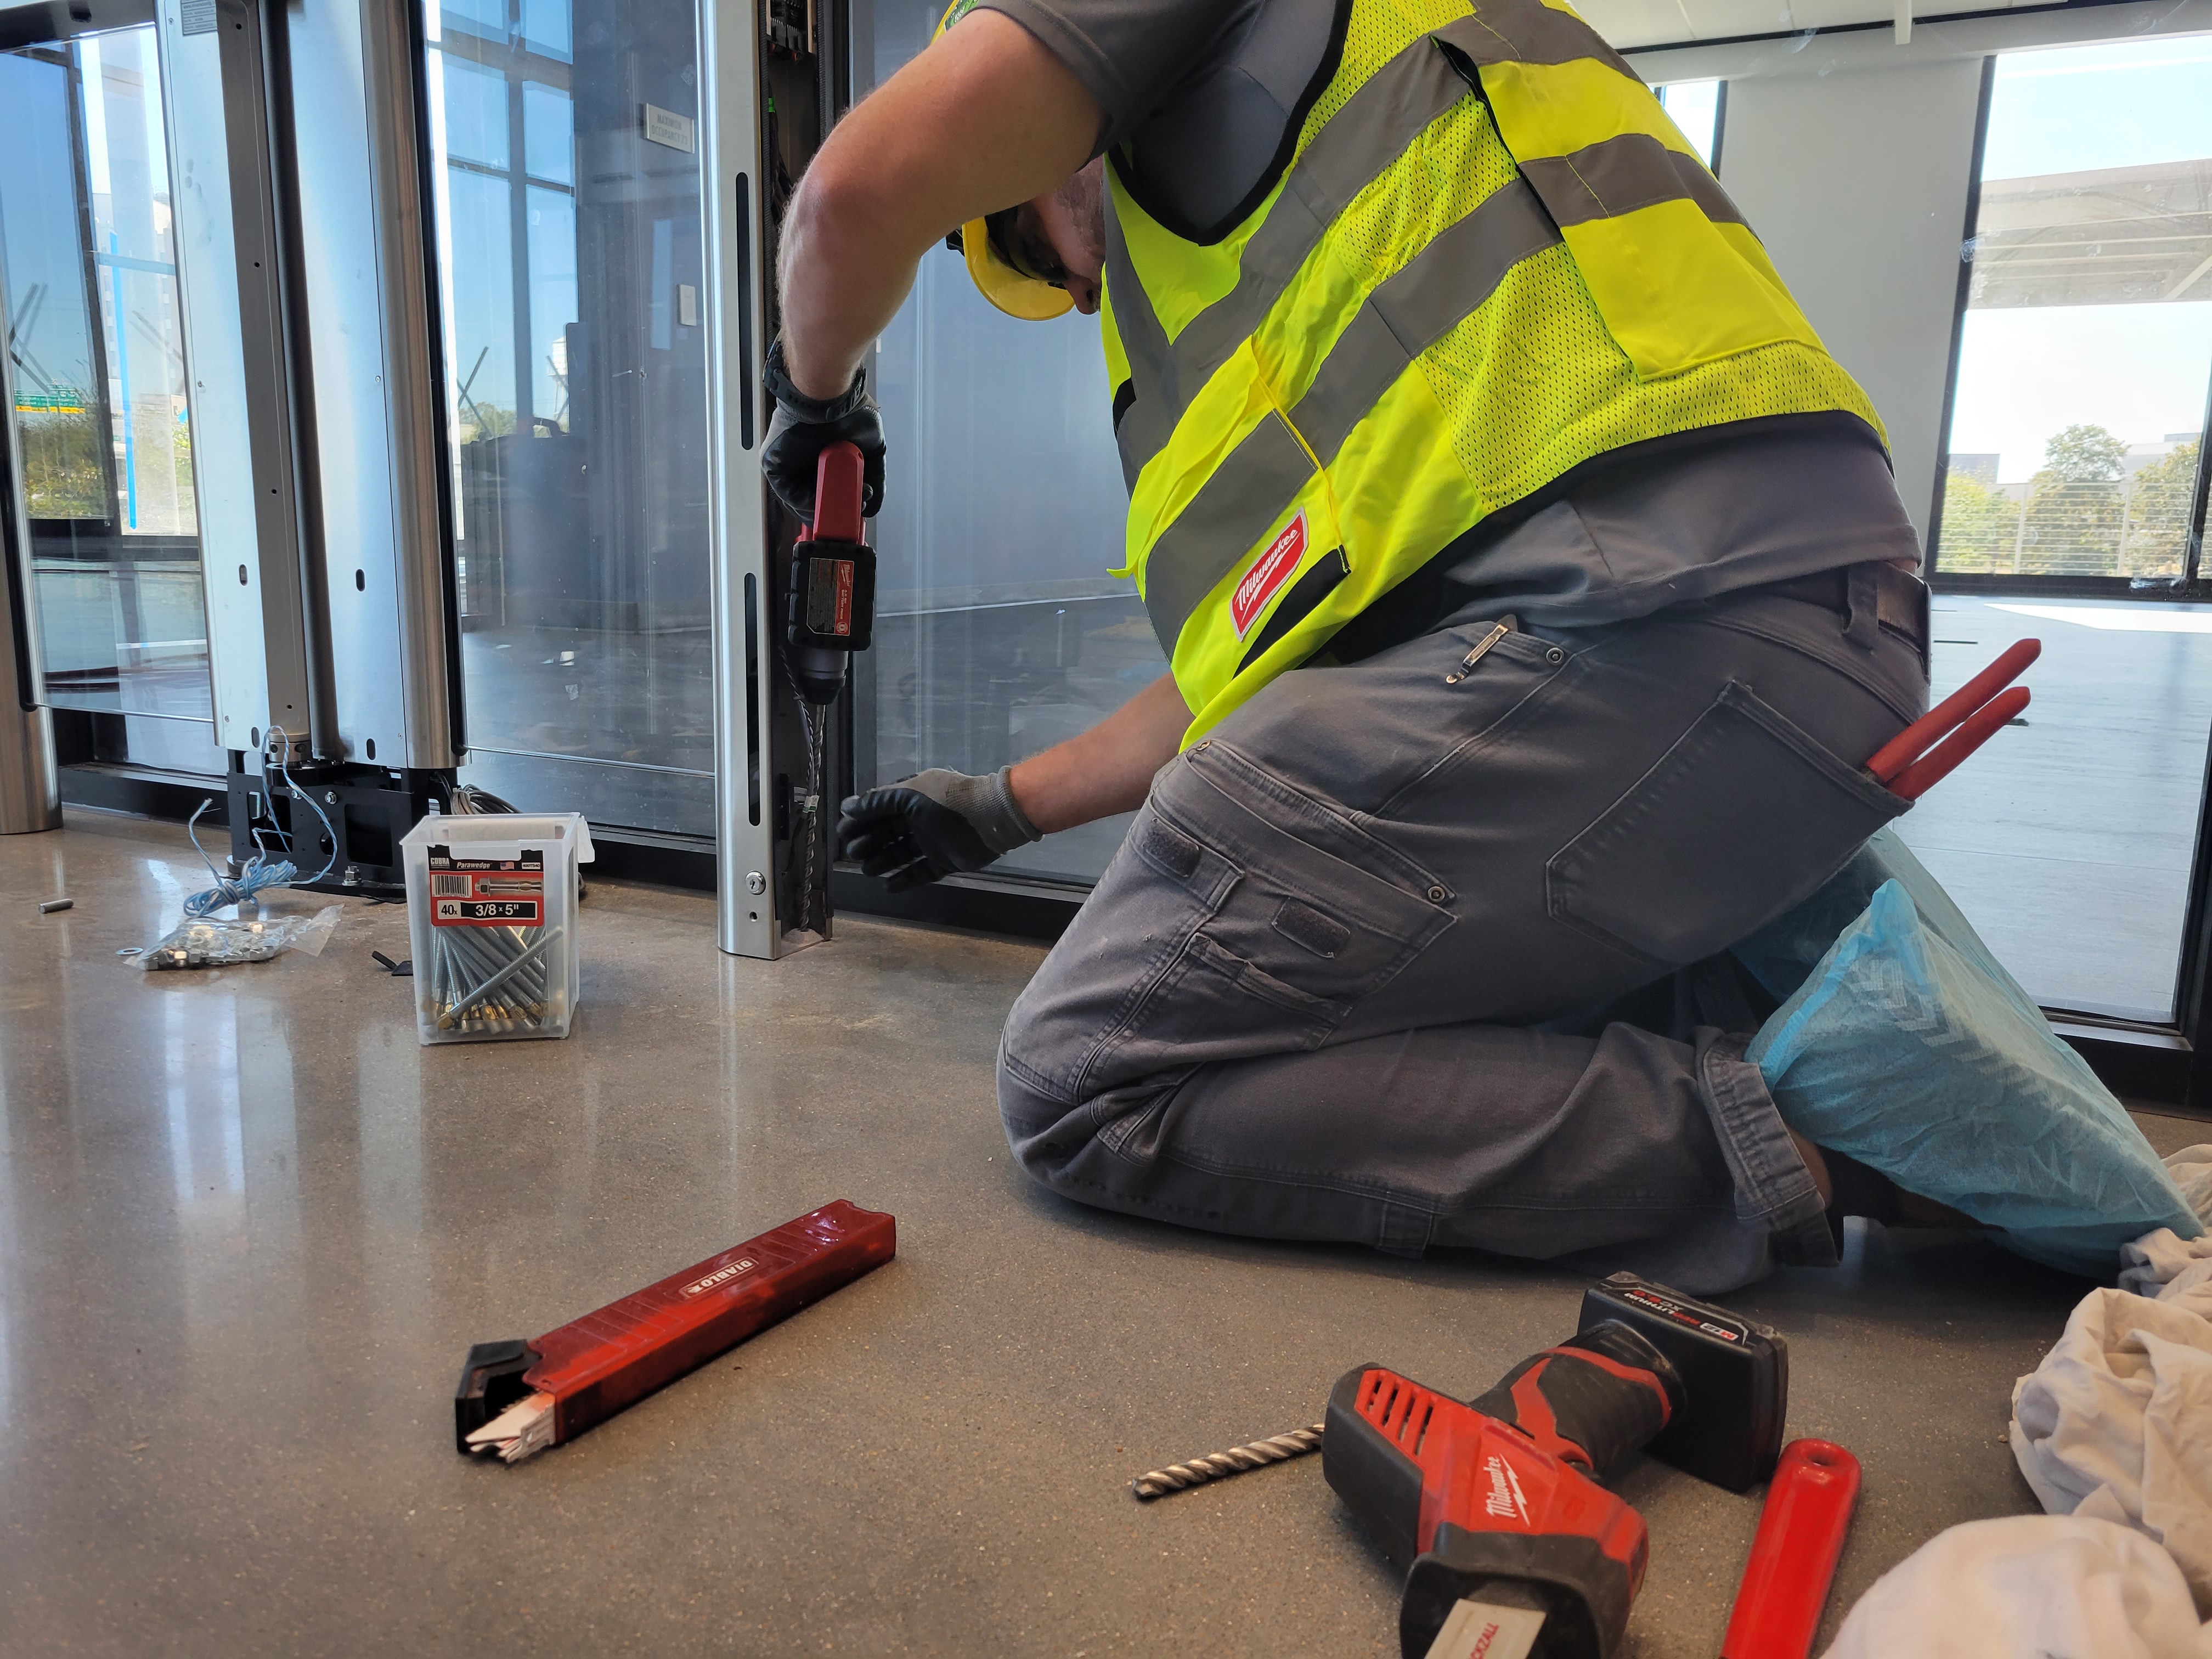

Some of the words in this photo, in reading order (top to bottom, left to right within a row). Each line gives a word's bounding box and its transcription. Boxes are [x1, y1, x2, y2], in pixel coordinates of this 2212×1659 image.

[1234, 529, 1299, 611] Milwaukee
[441, 904, 458, 915] 40x
[475, 904, 496, 917] 3/8
[505, 904, 519, 916] 5"
[700, 1260, 754, 1288] DIABLO
[1703, 1325, 1735, 1340] M12
[1483, 1456, 1517, 1518] Milwaukee
